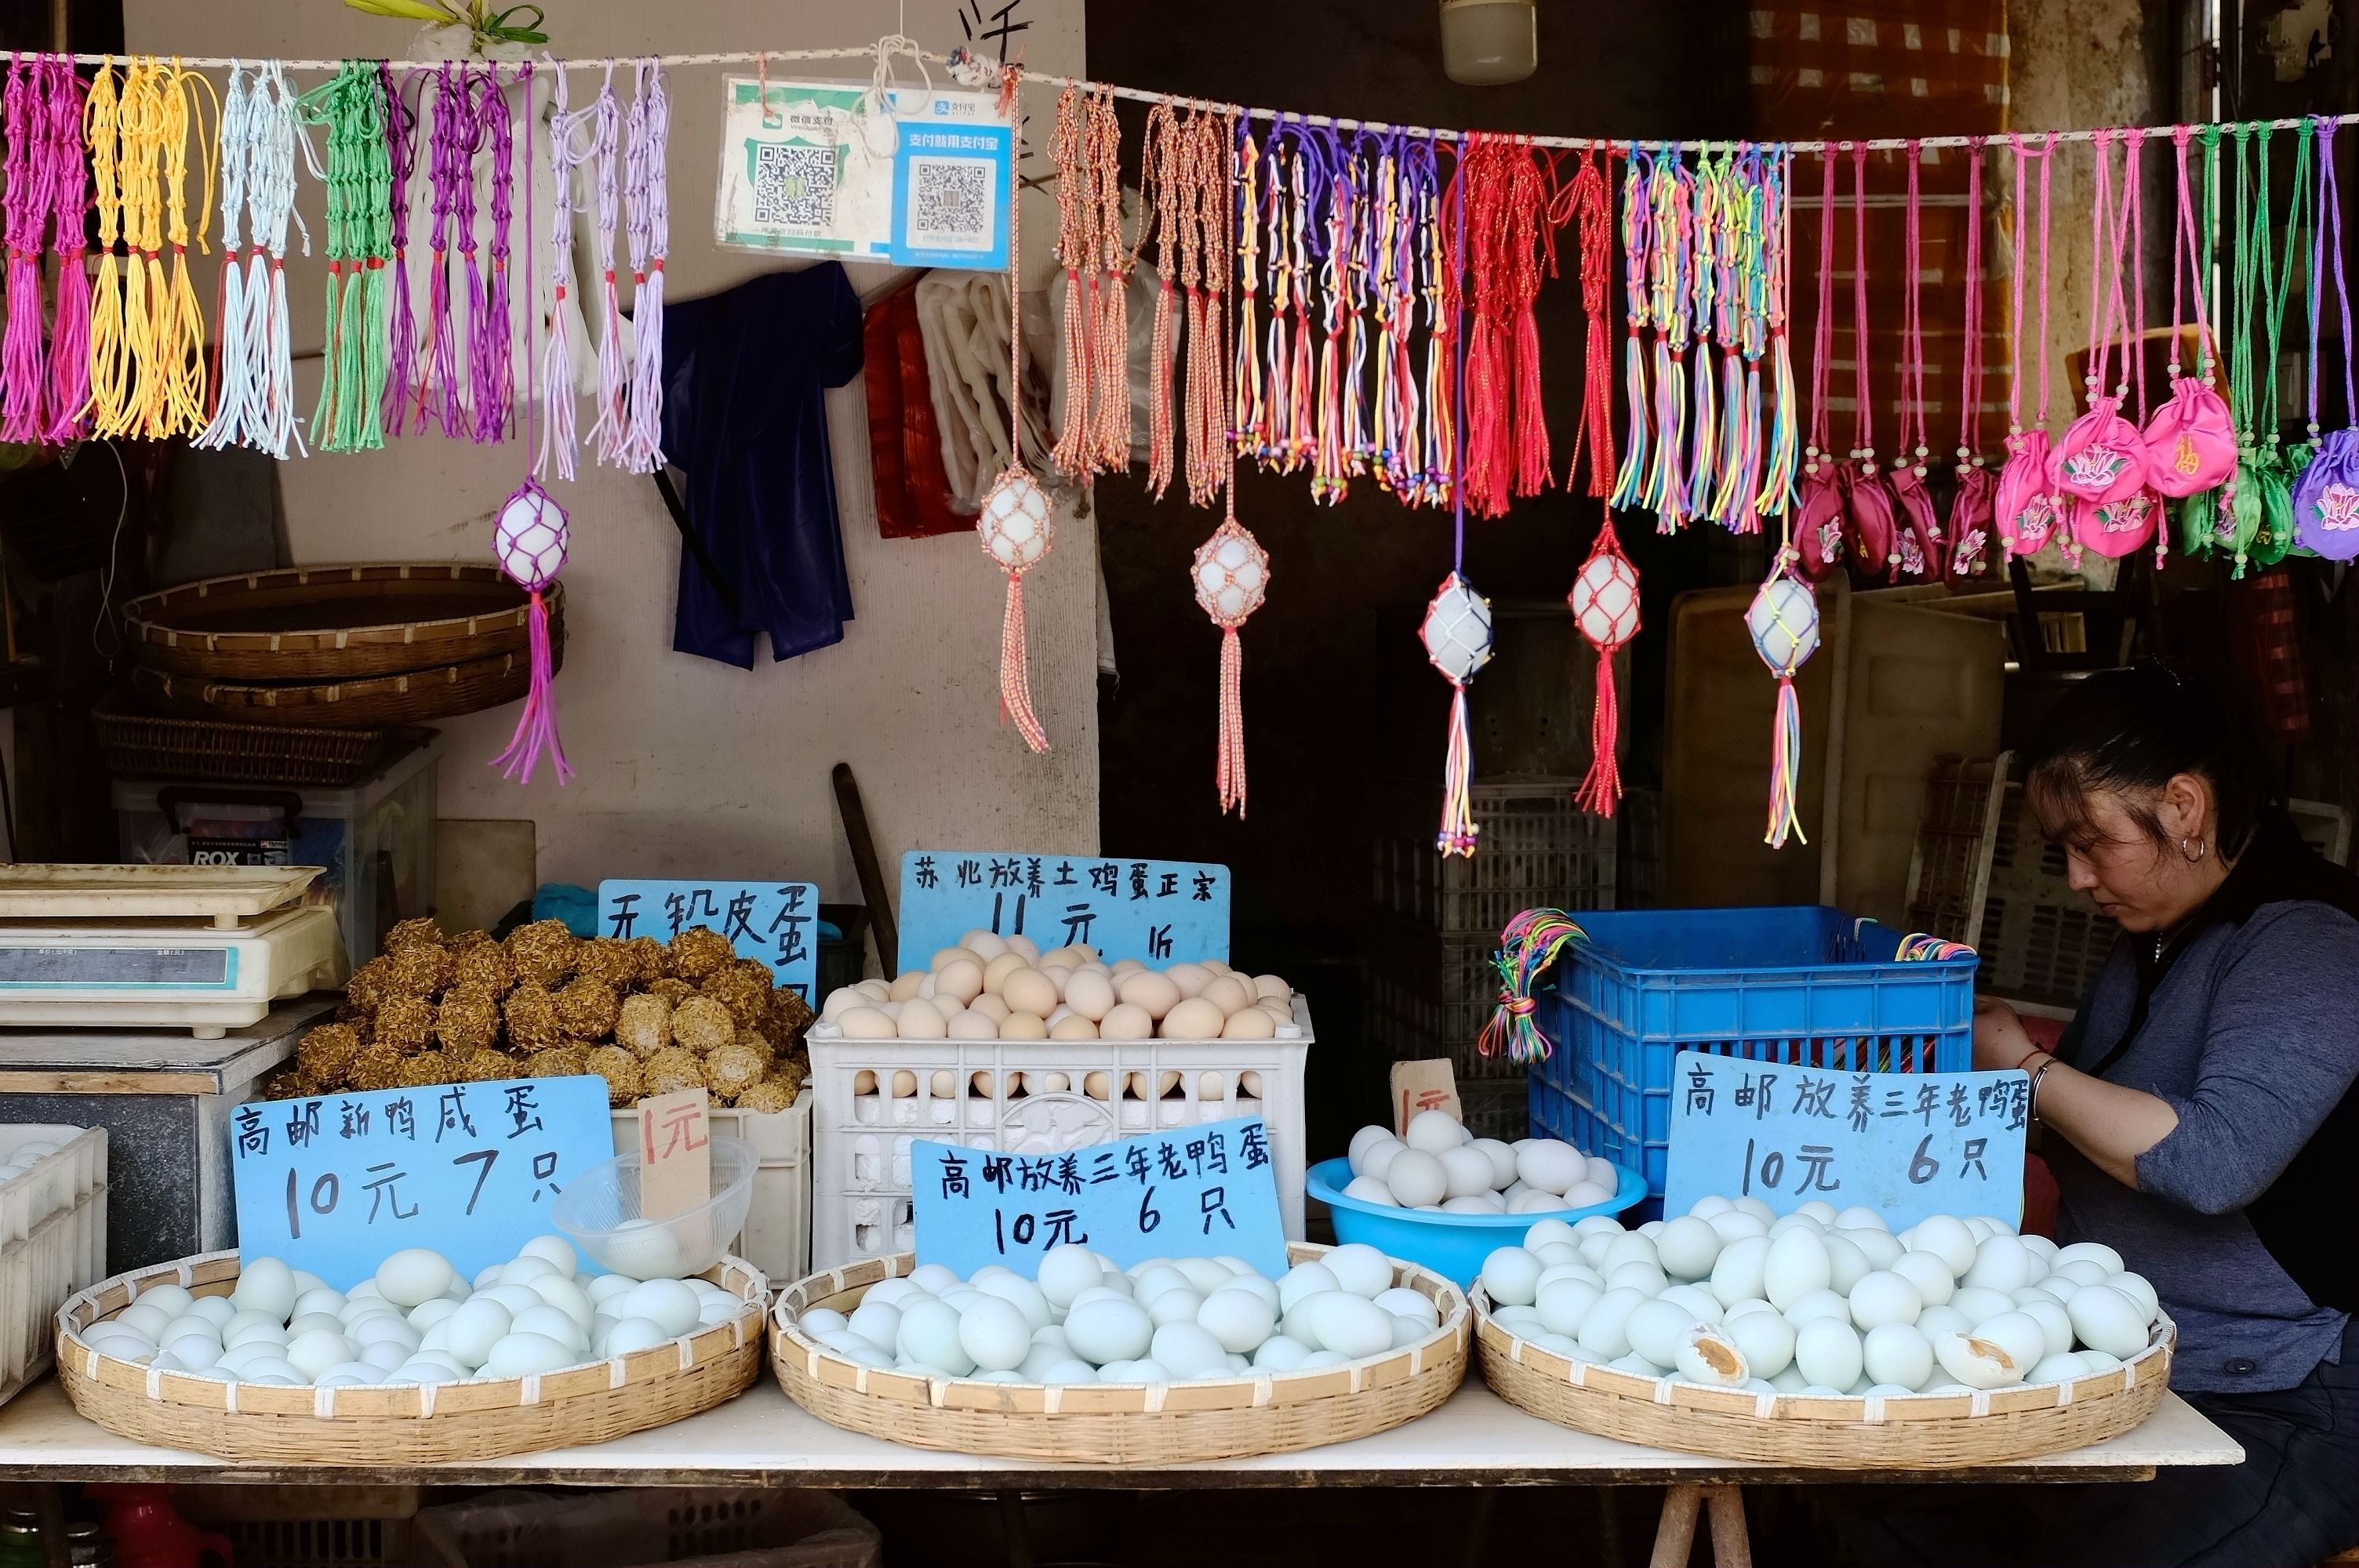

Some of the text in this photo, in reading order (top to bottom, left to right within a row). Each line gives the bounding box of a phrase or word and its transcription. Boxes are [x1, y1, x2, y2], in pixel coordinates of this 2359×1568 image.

[790, 114, 834, 125] 微信支付
[951, 102, 976, 112] 支付宝
[909, 132, 998, 151] 支付就用支付宝
[193, 851, 240, 866] ROX
[914, 855, 1216, 902] 苏北放养土鸡蛋正宗
[609, 886, 812, 967] 无铅皮蛋
[234, 1084, 543, 1159] 高邮新鸭咸蛋
[1686, 1062, 2027, 1133] 高邮放养三年老鸭蛋
[644, 1102, 708, 1164] 1元
[938, 1123, 1269, 1200] 高邮放养三年老鸭蛋
